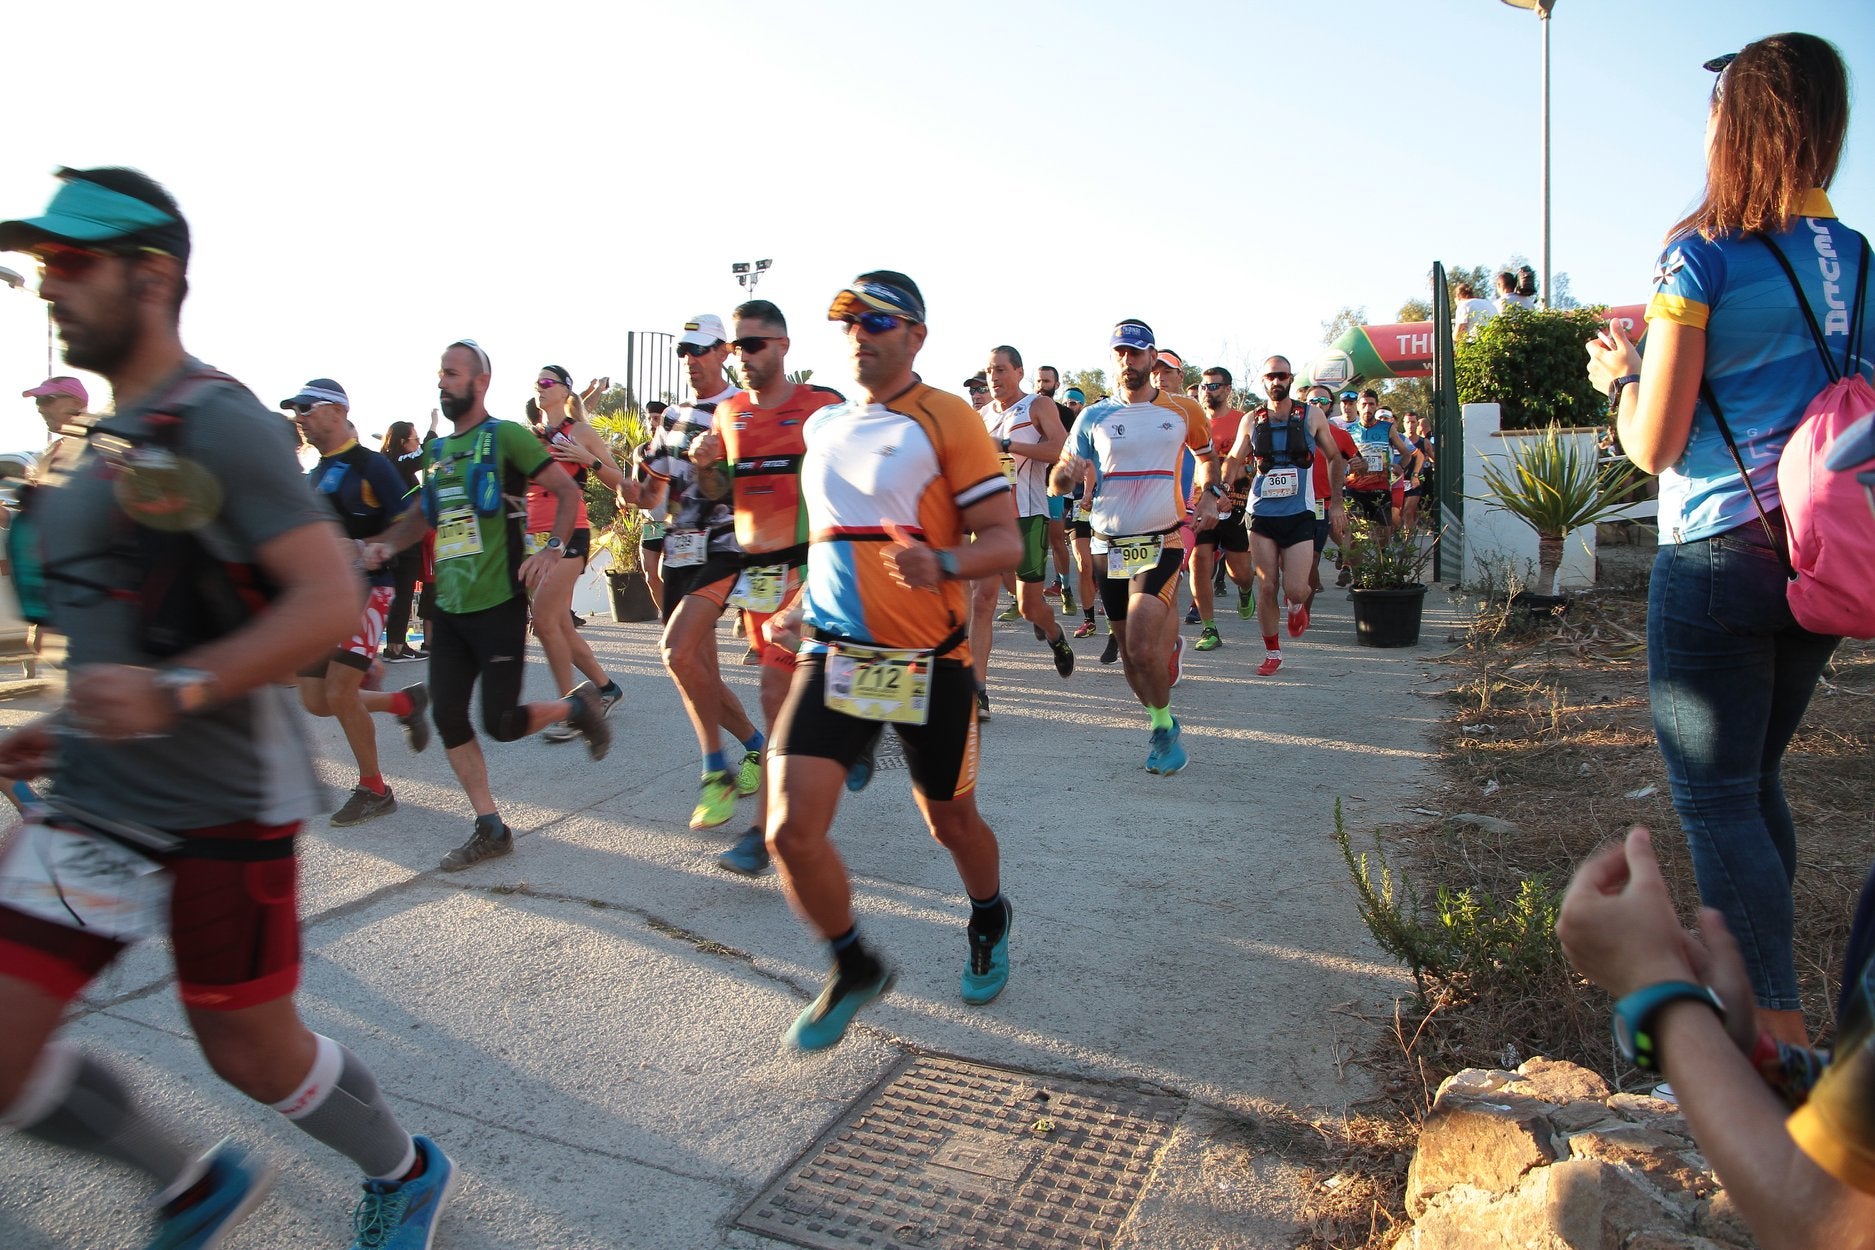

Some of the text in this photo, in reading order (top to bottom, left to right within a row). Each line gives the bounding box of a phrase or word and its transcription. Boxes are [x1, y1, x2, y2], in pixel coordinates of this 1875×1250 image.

[1269, 476, 1287, 486] 360
[1122, 547, 1148, 561] 900
[857, 666, 902, 689] 712
